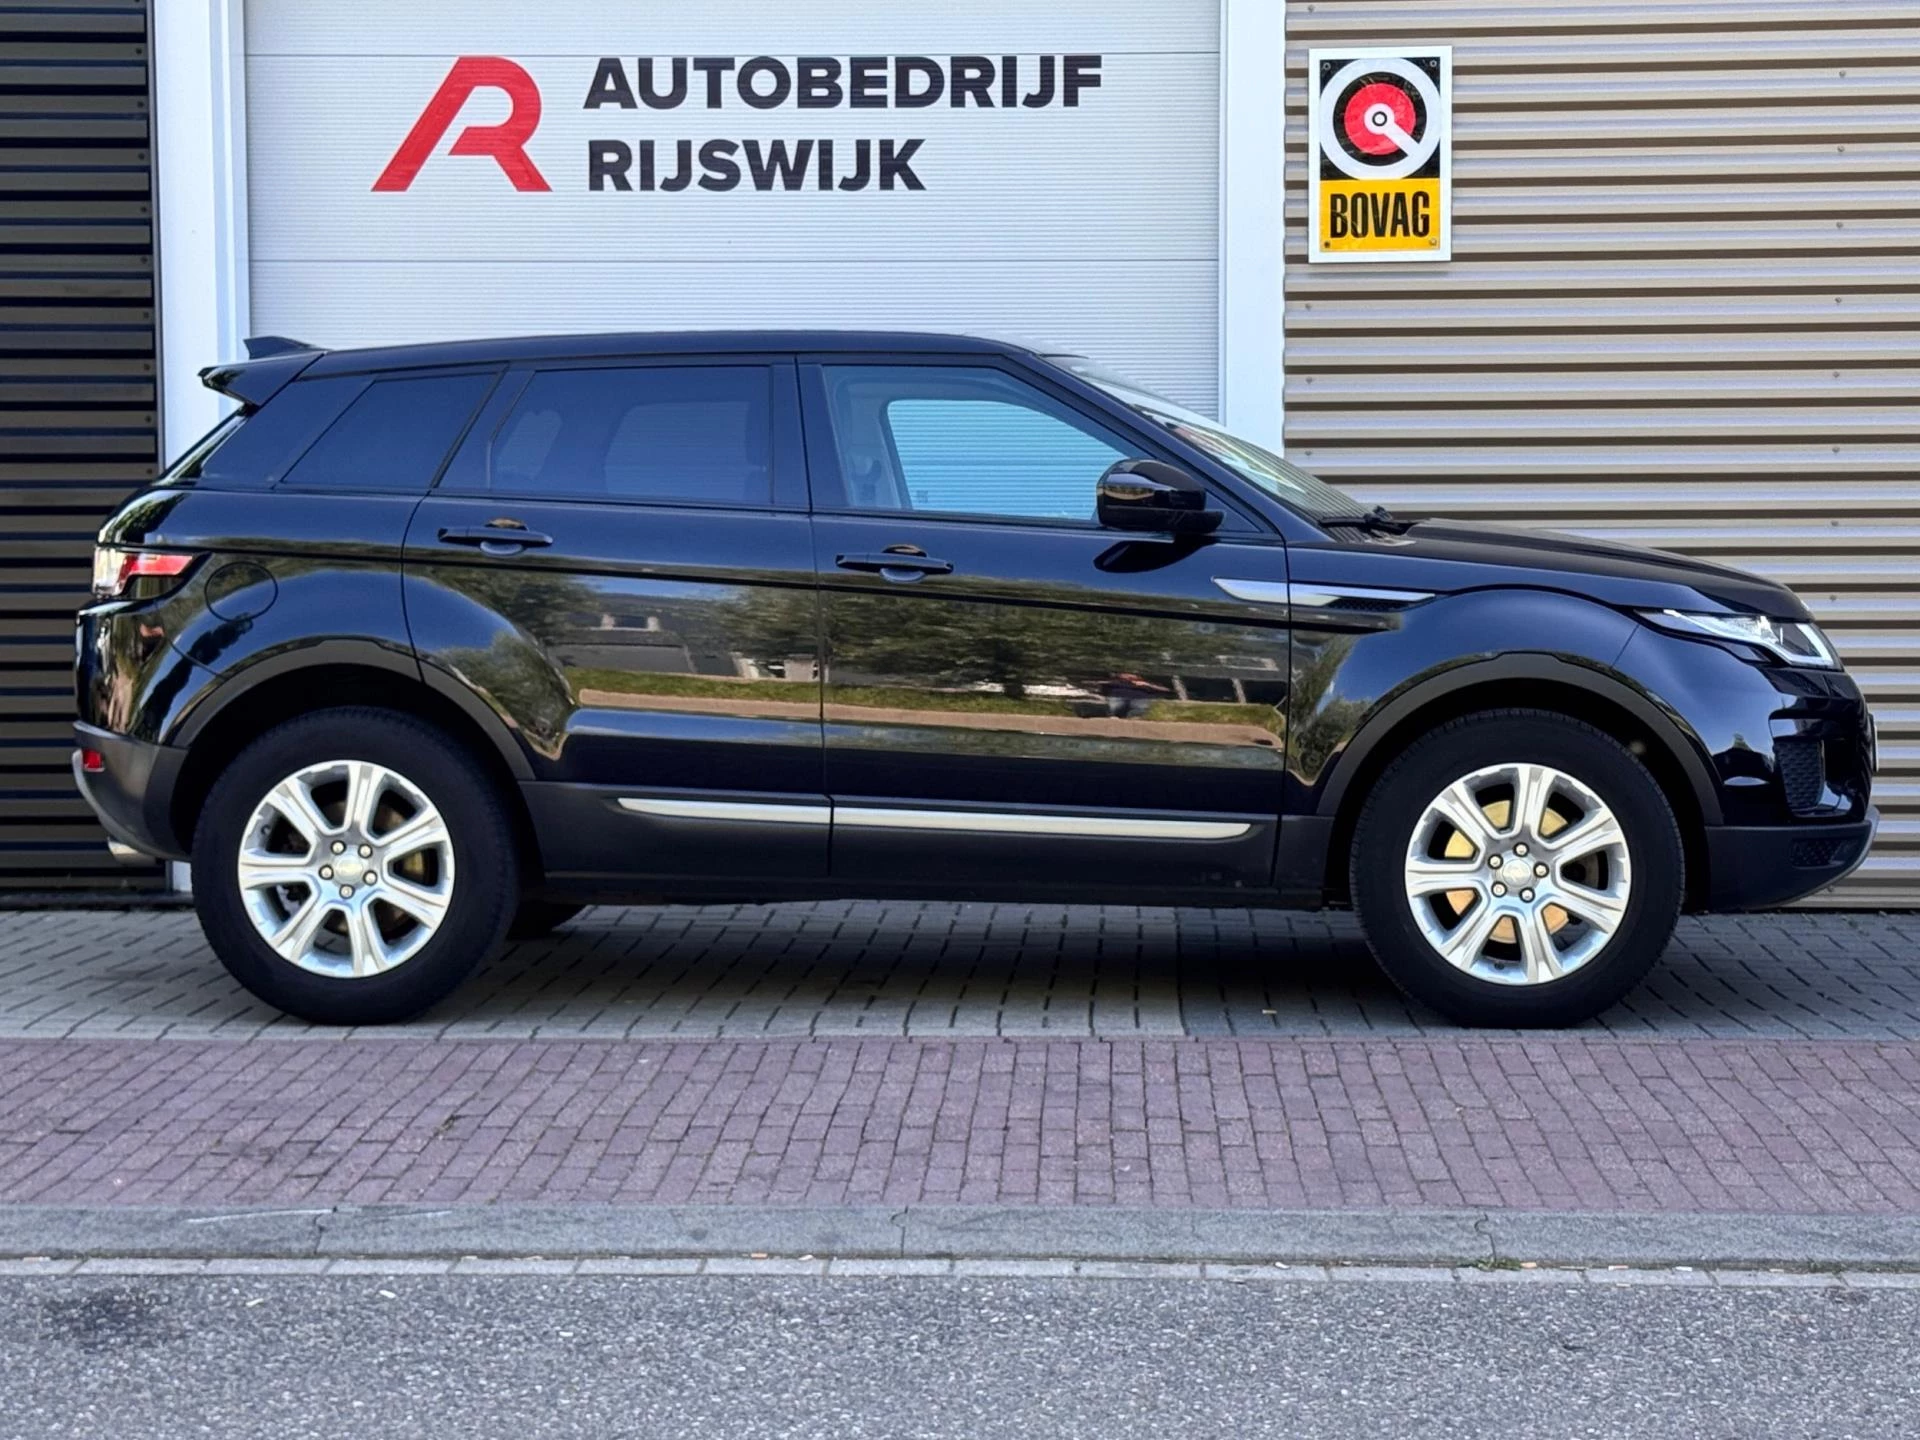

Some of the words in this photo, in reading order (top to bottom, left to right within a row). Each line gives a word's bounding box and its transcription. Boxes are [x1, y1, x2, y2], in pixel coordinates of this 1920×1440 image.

[583, 55, 1102, 110] AUTOBEDRIJF
[588, 138, 926, 192] RIJSWIJK
[1330, 190, 1430, 239] BOVAG
